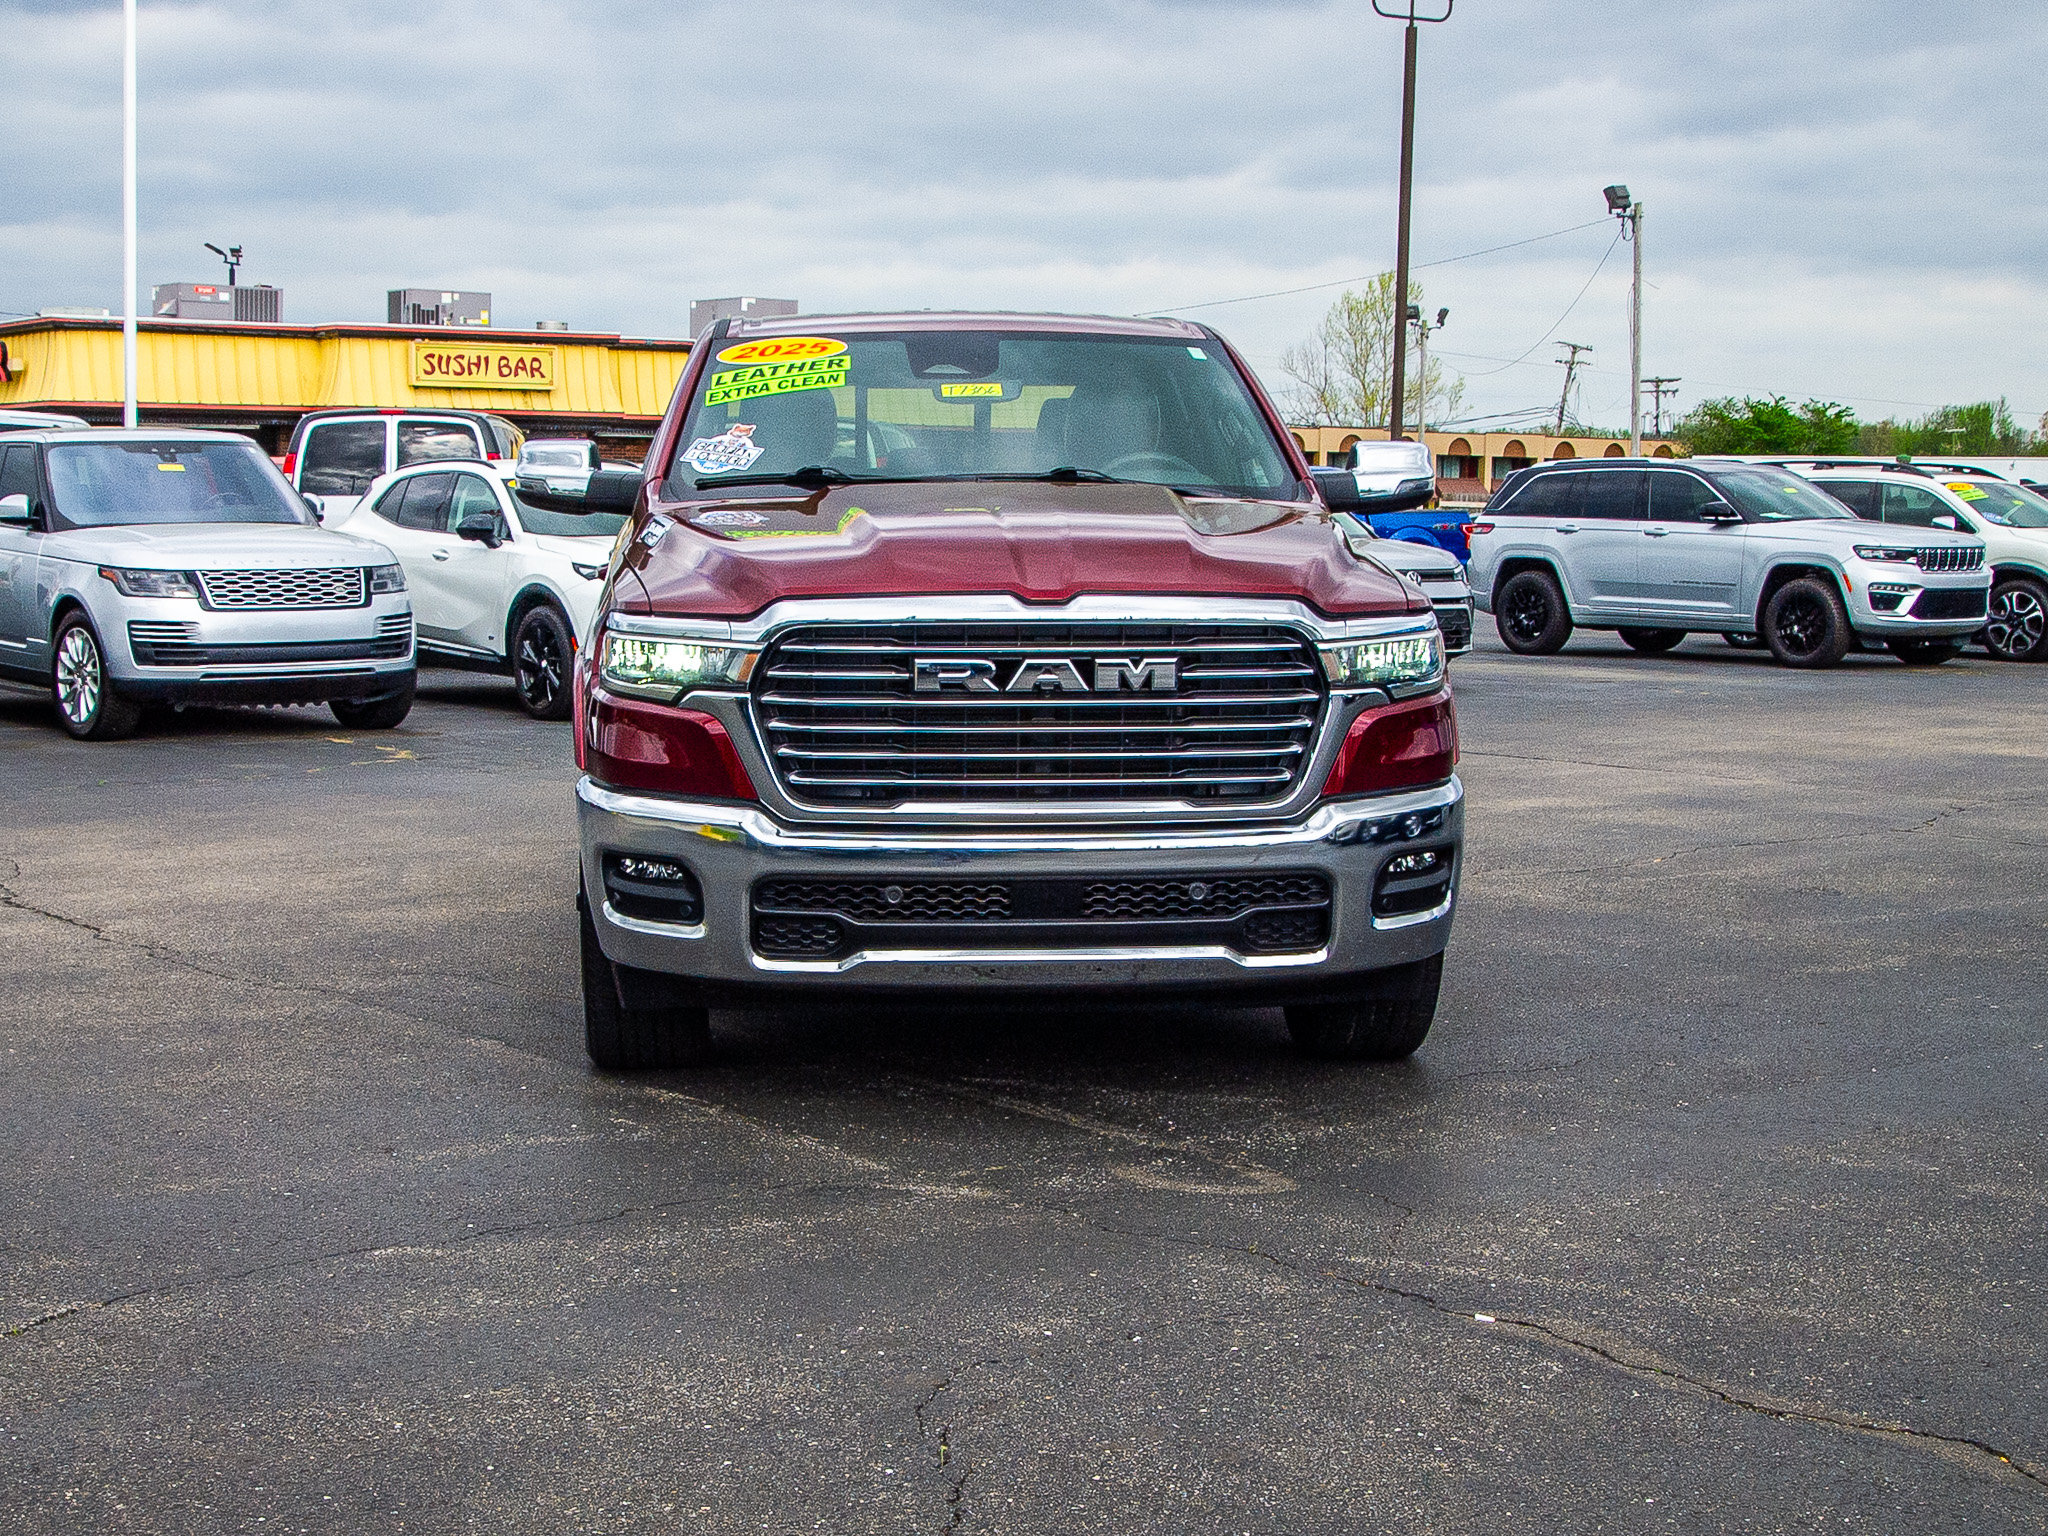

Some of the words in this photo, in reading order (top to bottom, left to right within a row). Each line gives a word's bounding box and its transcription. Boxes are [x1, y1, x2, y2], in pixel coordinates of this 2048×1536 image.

[422, 353, 490, 377] SUSHI
[497, 355, 546, 379] BAR
[731, 342, 833, 361] 2025
[714, 358, 845, 387] LEATHER
[708, 382, 770, 403] EXTRA
[777, 373, 841, 390] CLEAN
[914, 658, 1179, 692] RAM
